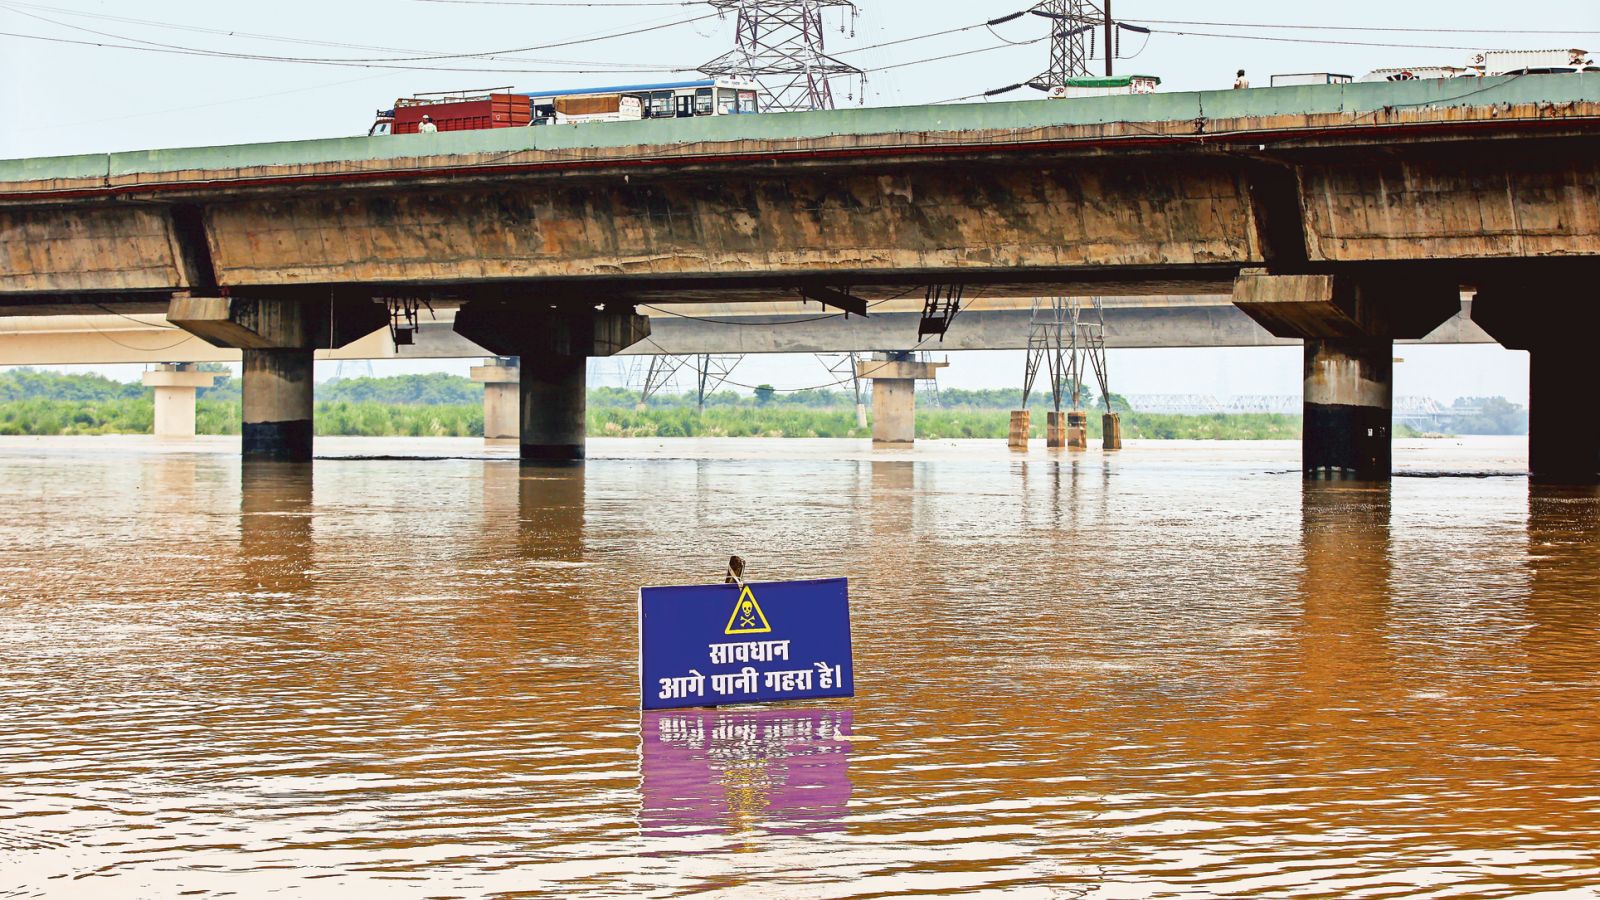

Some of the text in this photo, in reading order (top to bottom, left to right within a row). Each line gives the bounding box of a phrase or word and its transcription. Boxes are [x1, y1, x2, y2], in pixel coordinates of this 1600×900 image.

[708, 639, 791, 665] सावधान
[658, 661, 843, 700] आगे पानी गहरा है।
